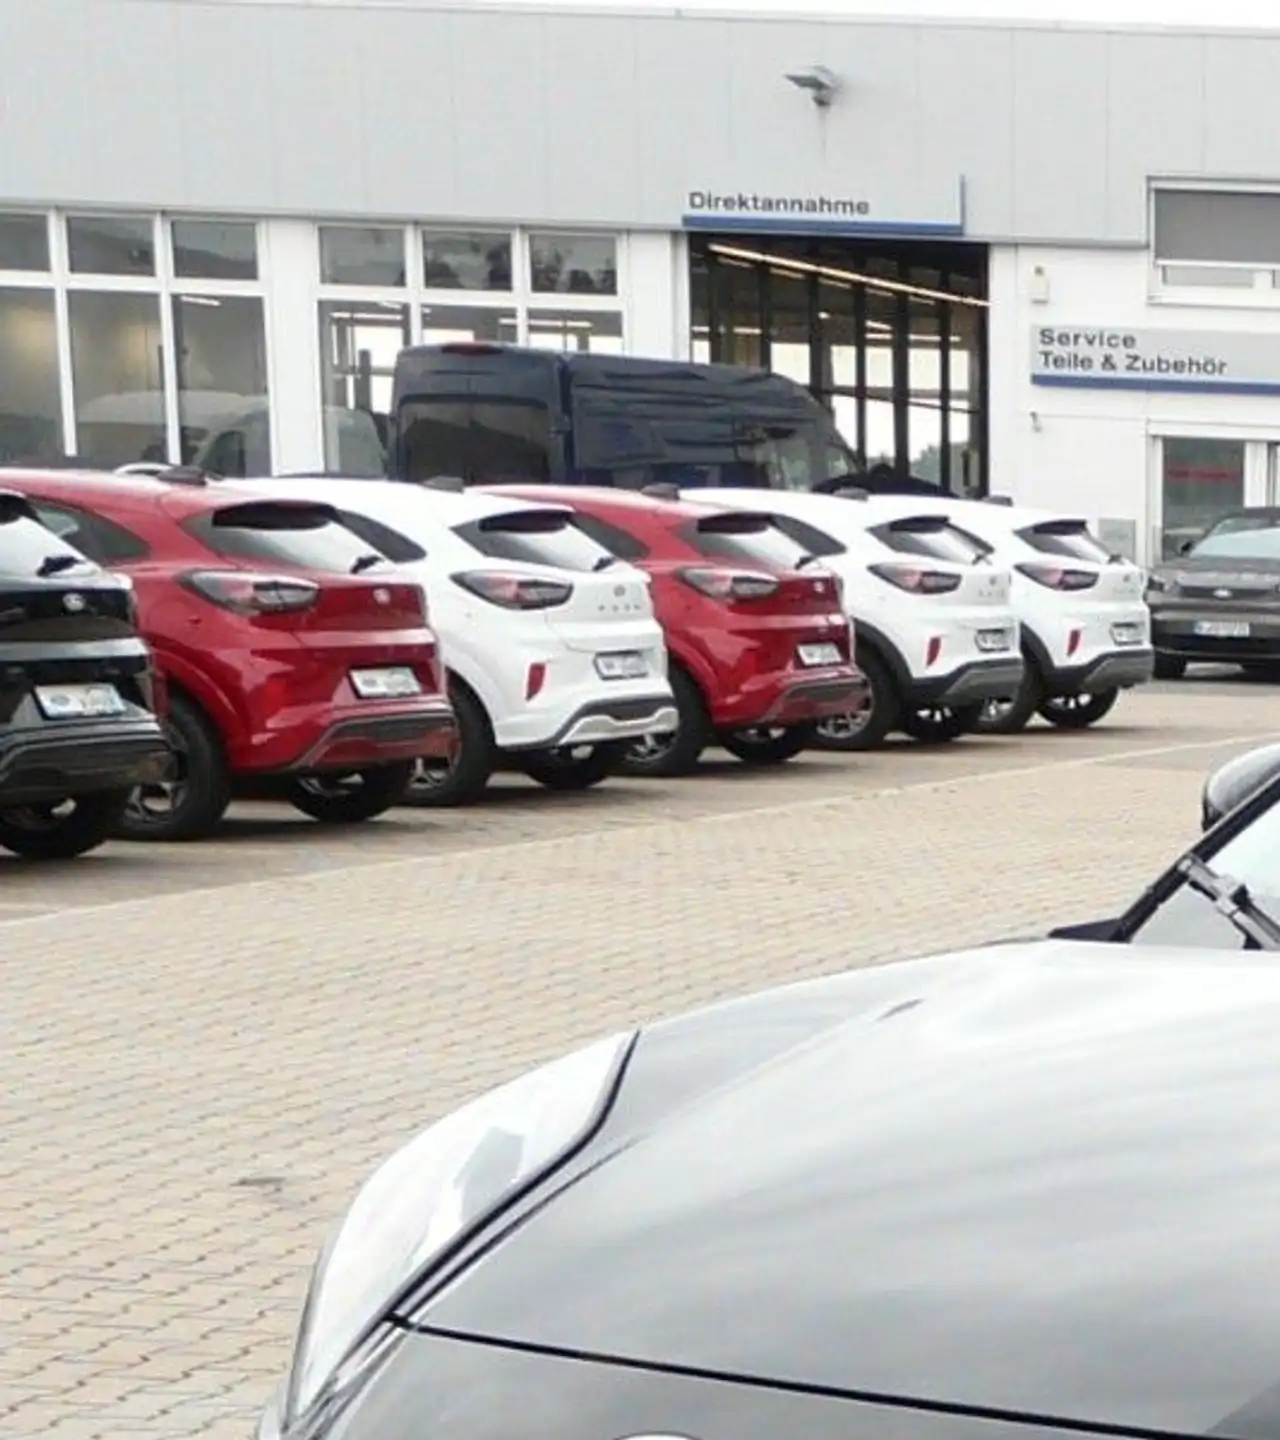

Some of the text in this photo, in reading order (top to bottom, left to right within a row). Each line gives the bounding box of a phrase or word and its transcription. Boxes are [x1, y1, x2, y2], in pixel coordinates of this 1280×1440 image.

[688, 191, 870, 216] Direktannahme
[1039, 328, 1137, 349] Service
[1040, 351, 1228, 374] Teile & Zubehör
